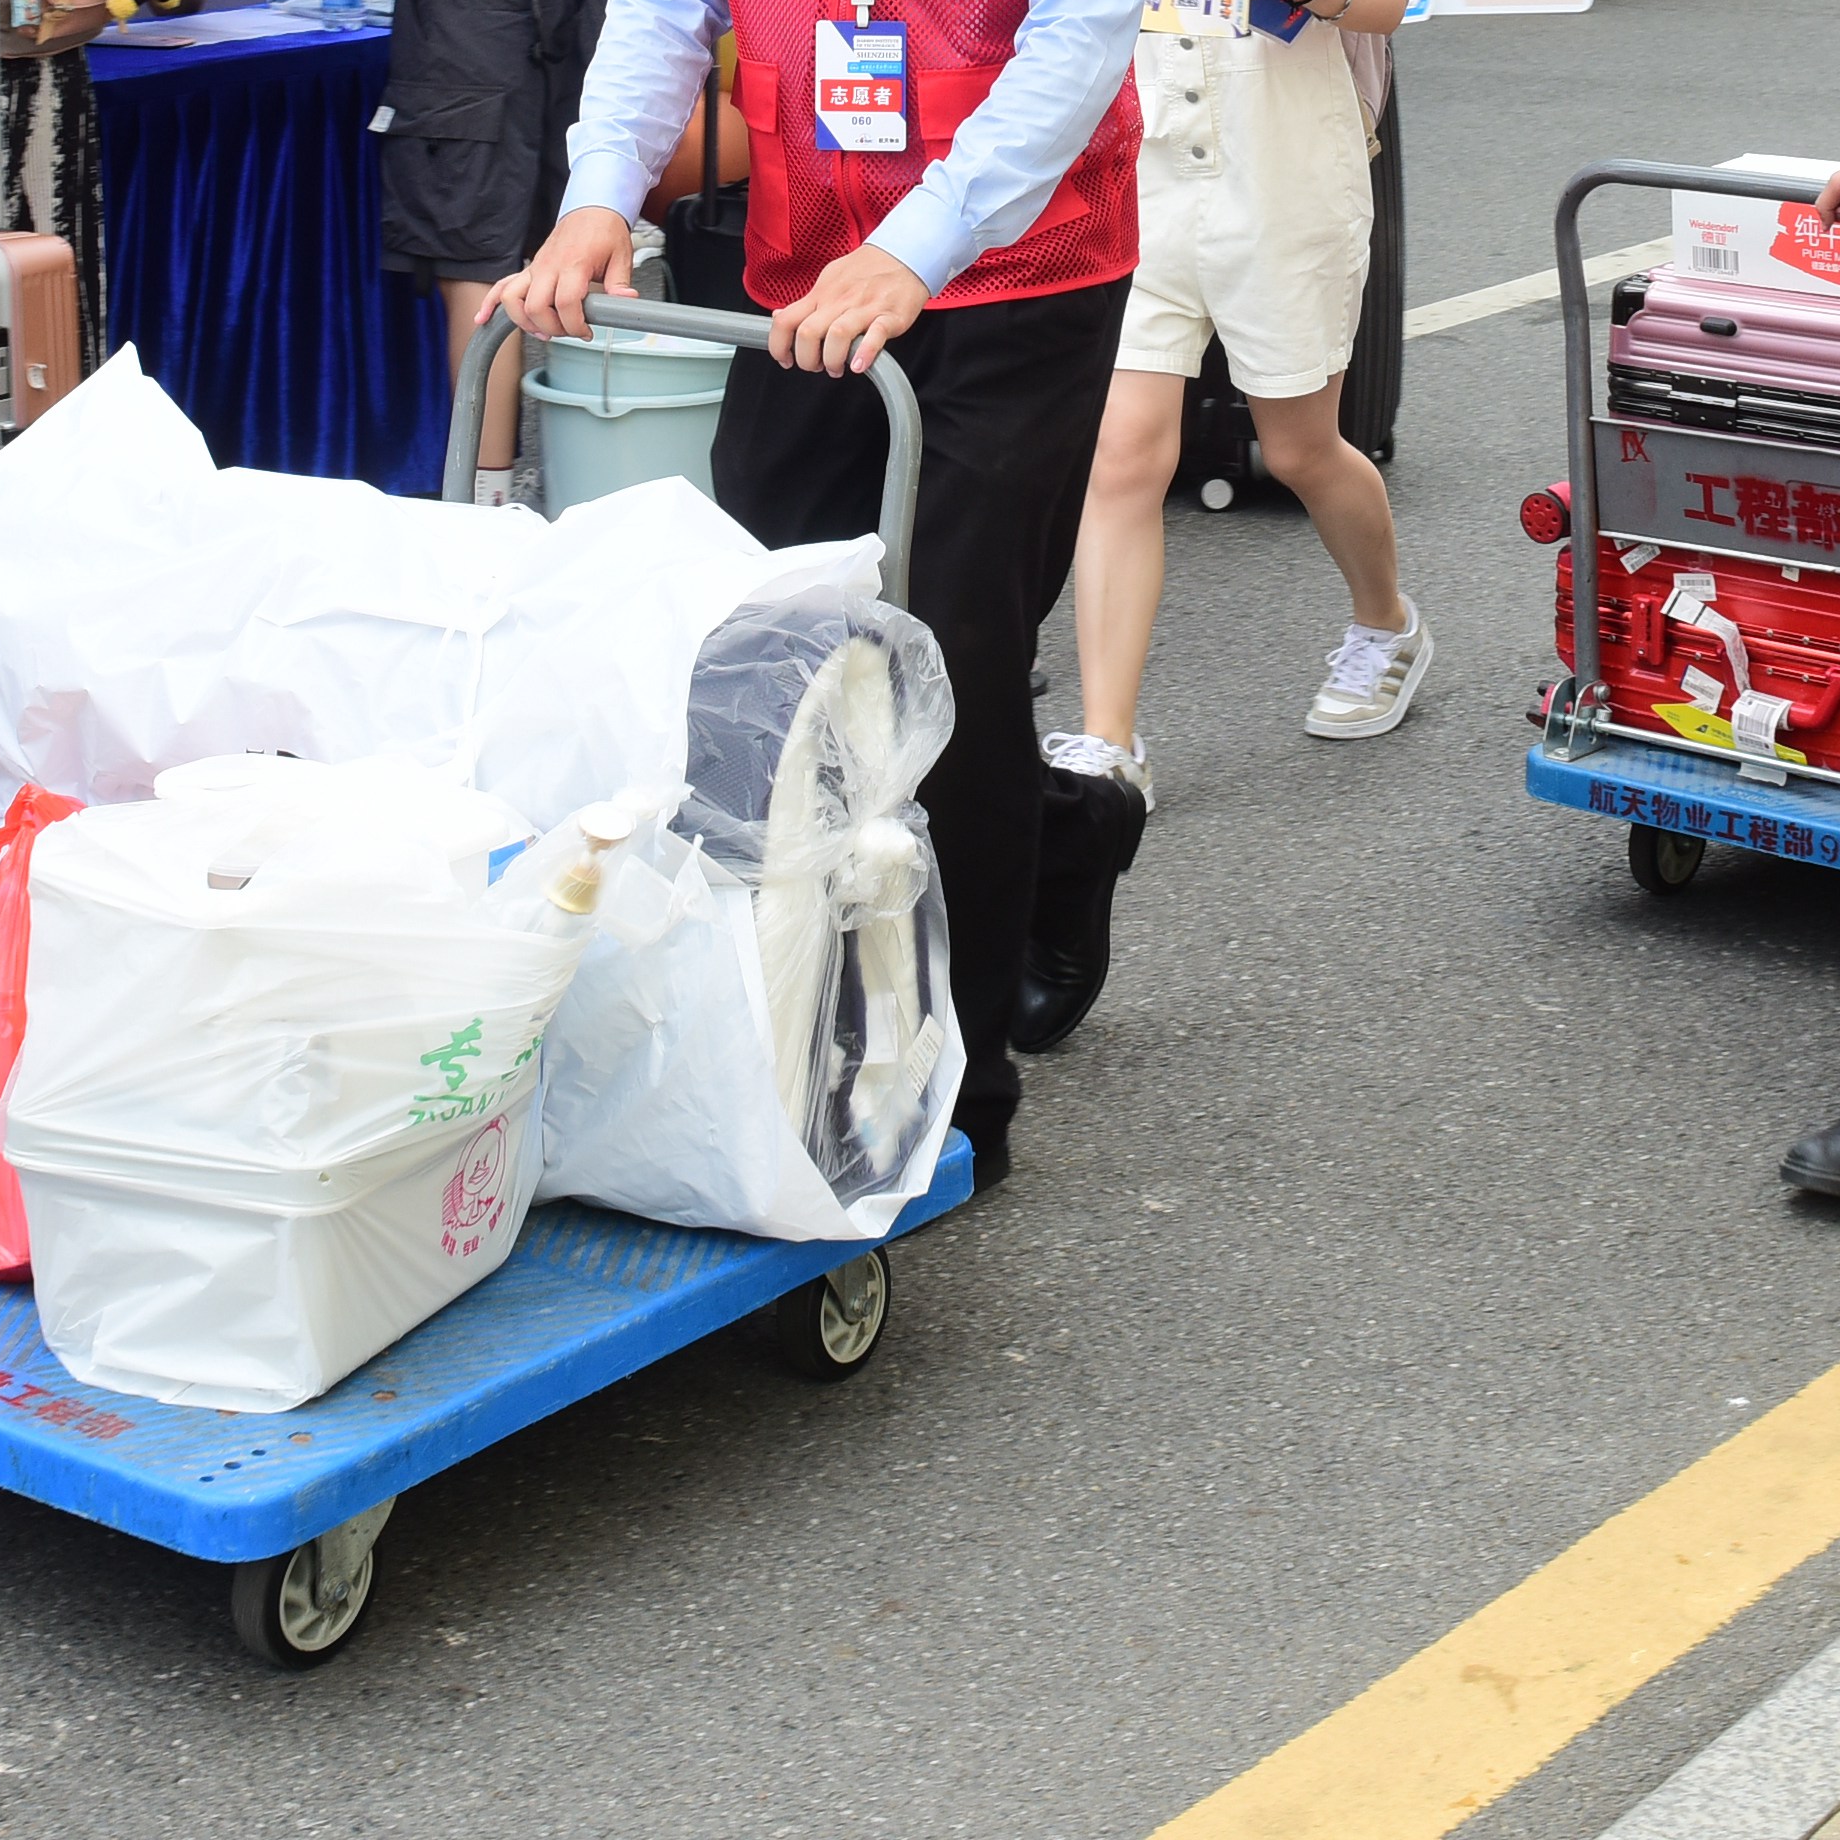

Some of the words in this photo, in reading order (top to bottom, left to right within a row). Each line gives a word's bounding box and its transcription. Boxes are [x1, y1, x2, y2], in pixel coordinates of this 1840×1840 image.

[856, 51, 899, 59] SHENZHEN
[829, 85, 893, 106] 志愿者
[851, 116, 872, 126] 060
[1688, 219, 1739, 234] Weidendorf
[1801, 248, 1832, 262] PURE
